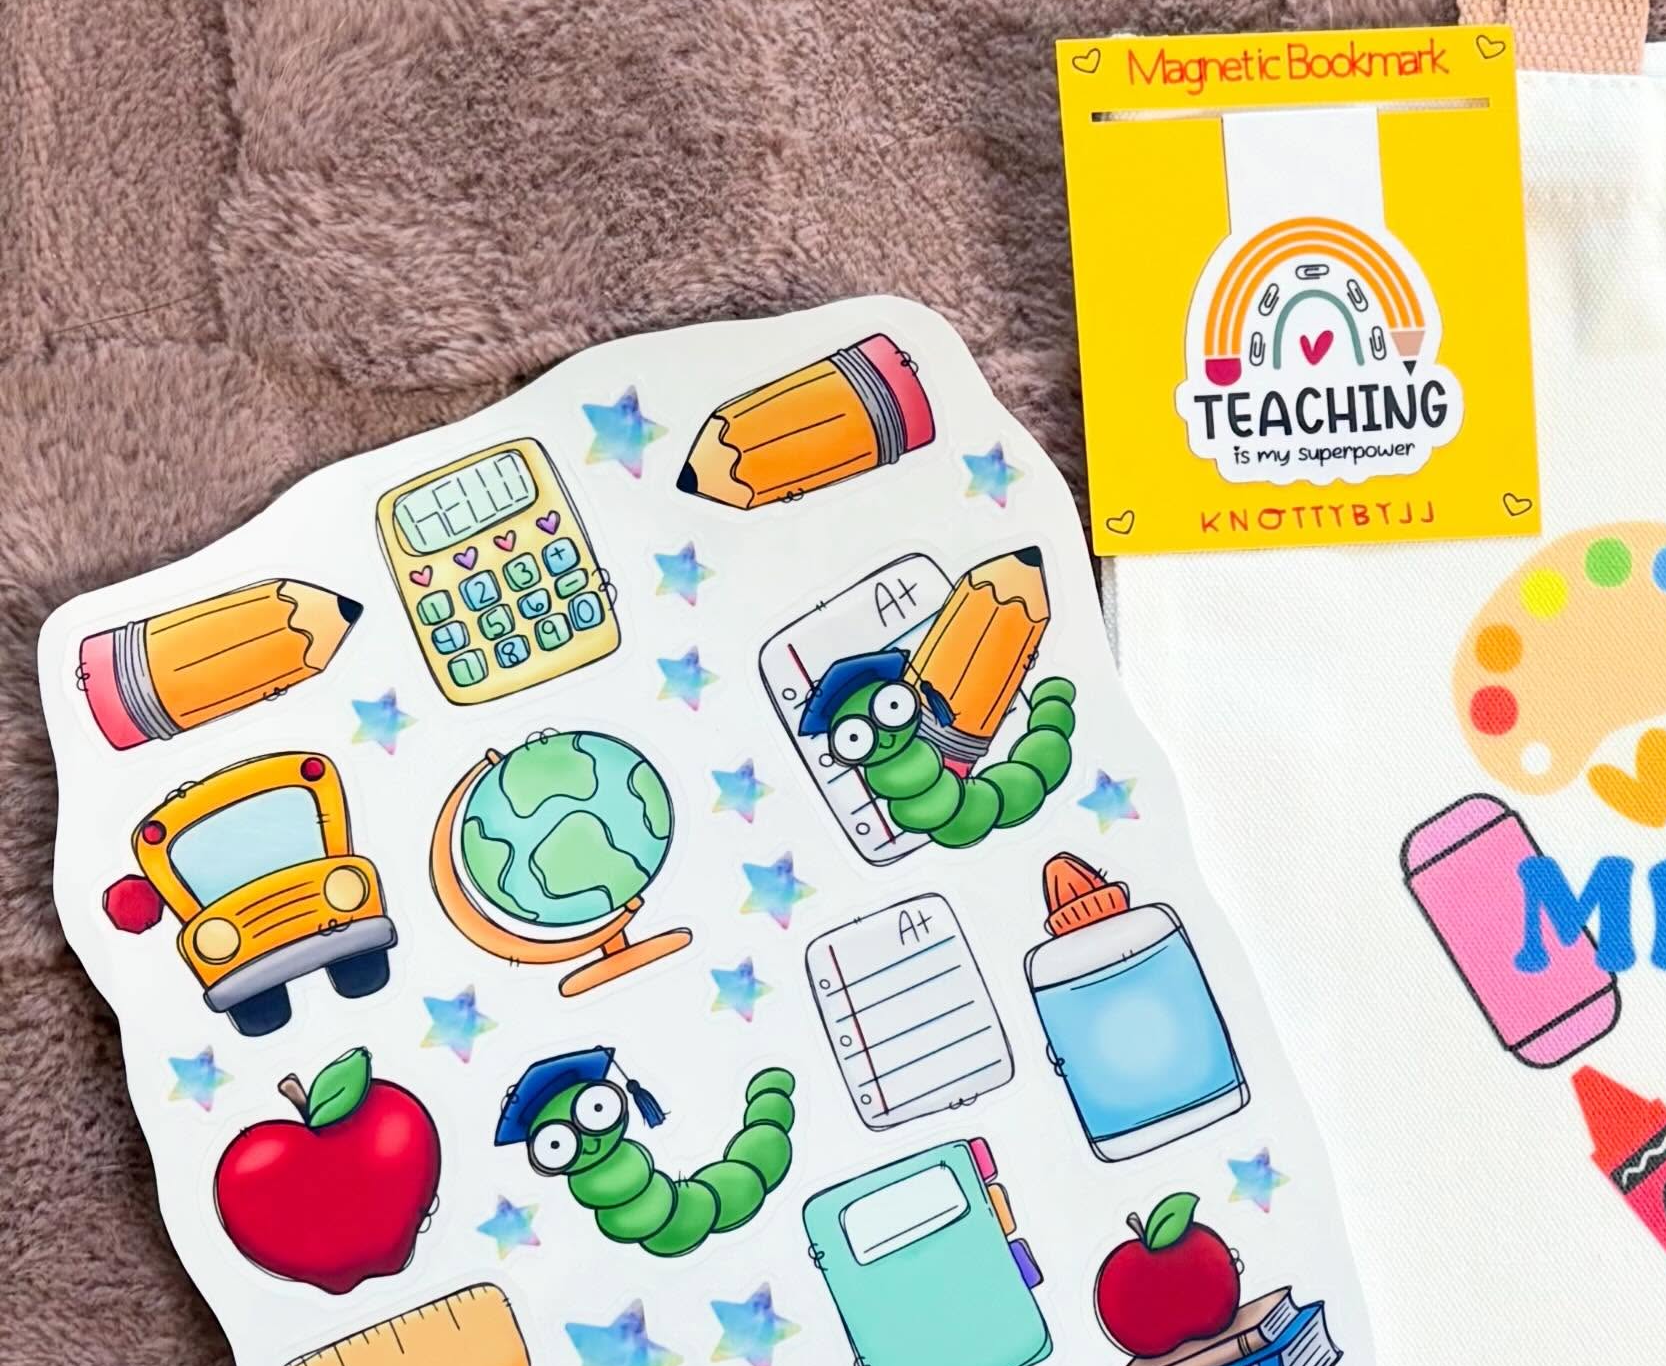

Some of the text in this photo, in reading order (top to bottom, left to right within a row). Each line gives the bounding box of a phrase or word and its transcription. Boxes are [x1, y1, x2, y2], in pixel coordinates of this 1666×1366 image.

[1128, 38, 1450, 96] Magnetic Bookmark
[1194, 379, 1449, 440] TEACHING
[1233, 443, 1415, 467] is my superpower
[474, 581, 495, 604] 2
[514, 561, 534, 586] 3
[874, 578, 918, 628] A+
[435, 626, 458, 649] 4
[486, 608, 507, 636] 5
[526, 596, 545, 614] 6
[450, 598, 595, 681] 7 8 9 0
[898, 909, 933, 946] A+
